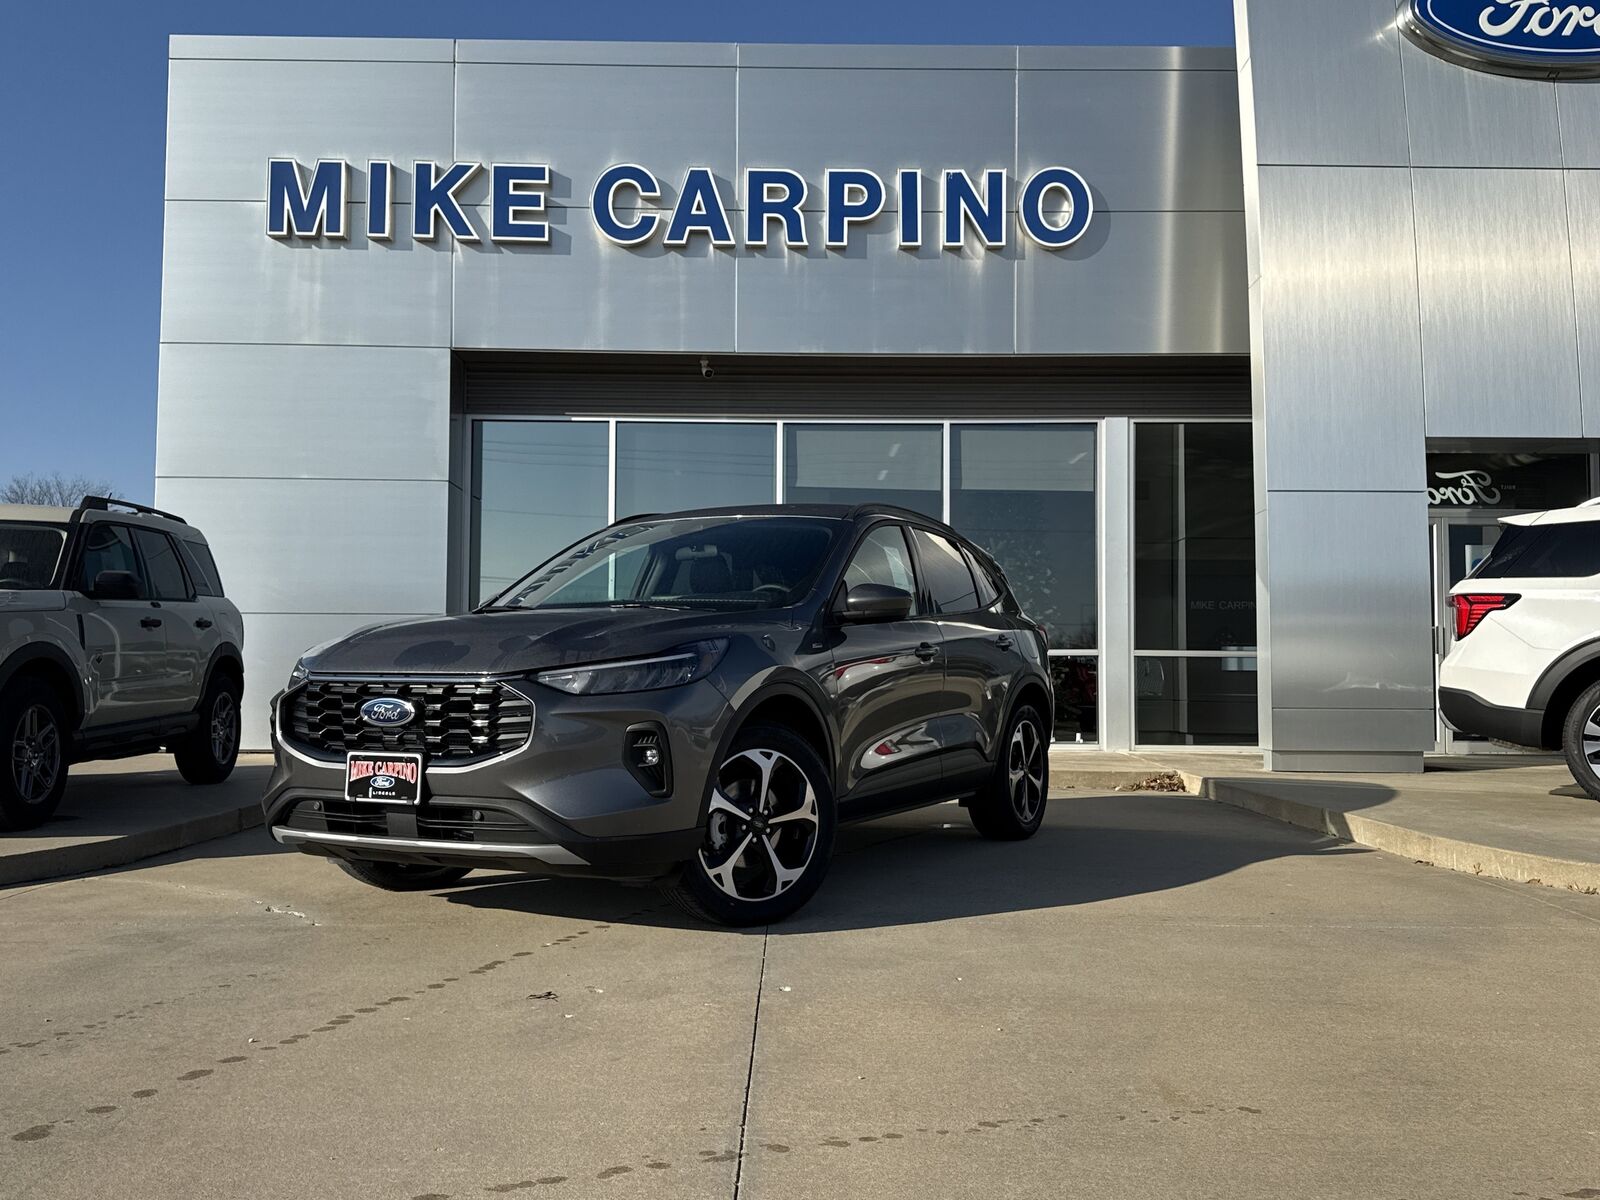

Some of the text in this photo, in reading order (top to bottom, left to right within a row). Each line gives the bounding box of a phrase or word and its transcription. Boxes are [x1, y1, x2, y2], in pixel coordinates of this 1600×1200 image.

[1479, 0, 1600, 36] For
[266, 157, 1094, 250] MIKE CARPINO
[1190, 600, 1216, 609] MIKE
[371, 703, 401, 720] Ford
[350, 760, 417, 784] MIKE CARPINO
